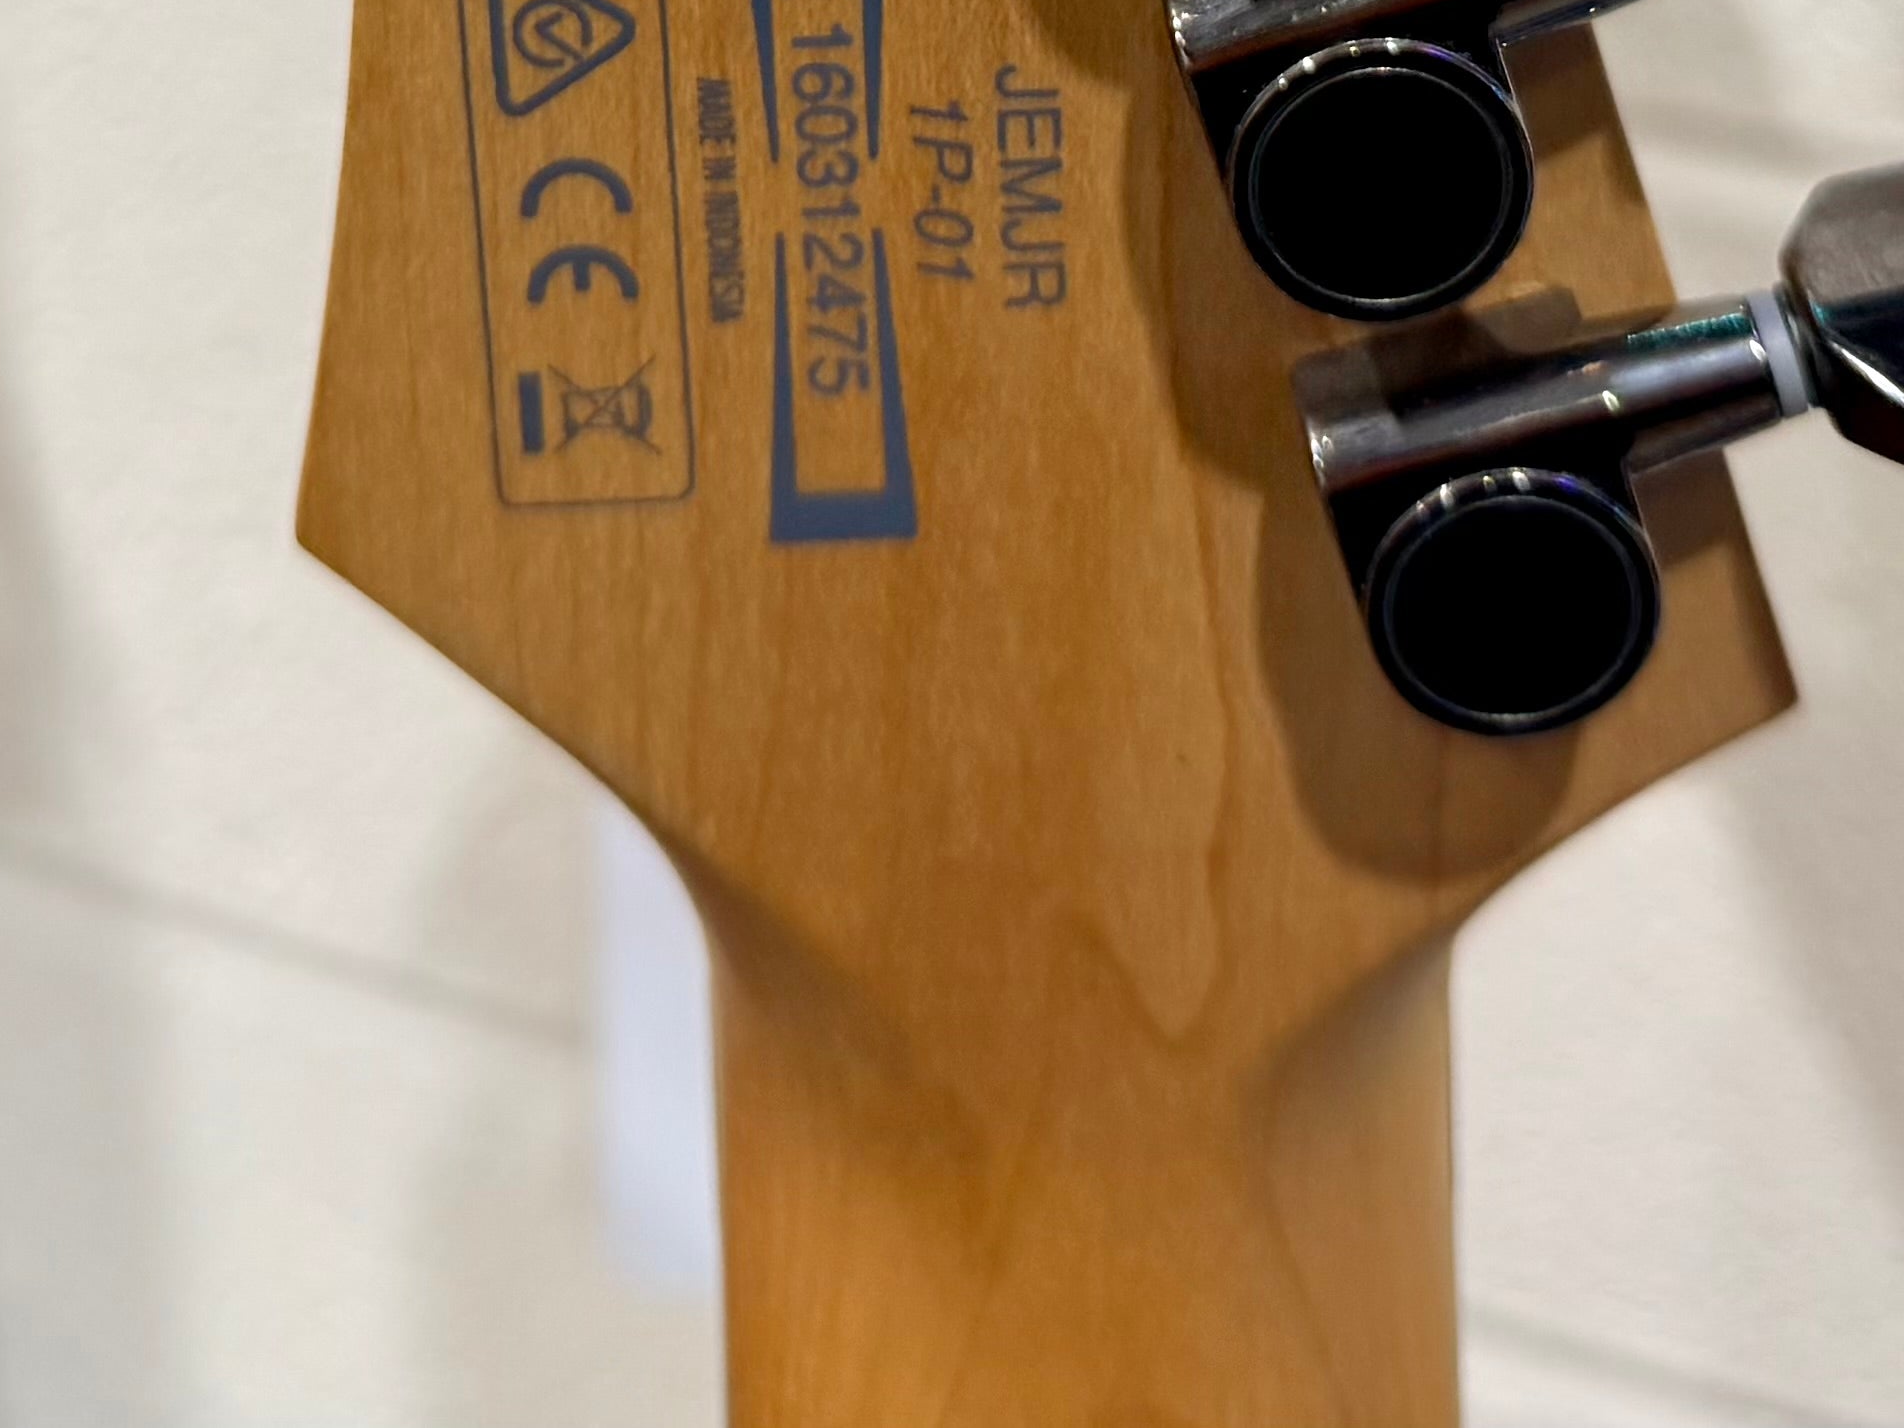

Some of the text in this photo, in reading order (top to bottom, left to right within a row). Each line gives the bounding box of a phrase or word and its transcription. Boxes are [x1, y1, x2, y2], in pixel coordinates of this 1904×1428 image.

[698, 77, 737, 146] MADE
[702, 154, 737, 183] IN
[908, 100, 975, 284] 1P-01
[994, 64, 1067, 310] JEMJR
[790, 22, 870, 400] 160312475
